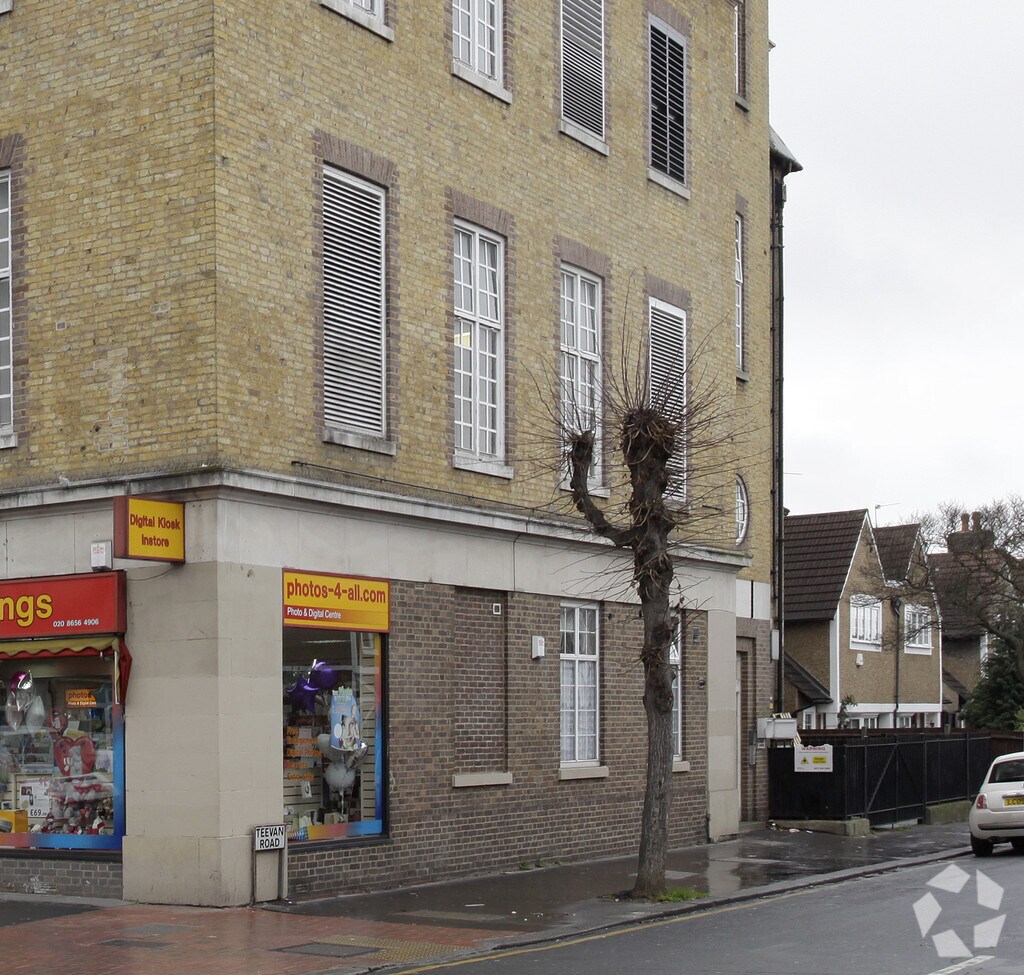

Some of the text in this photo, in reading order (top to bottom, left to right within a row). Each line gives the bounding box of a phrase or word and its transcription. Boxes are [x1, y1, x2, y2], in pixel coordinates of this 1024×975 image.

[130, 514, 181, 530] Digital Kiosk
[141, 534, 170, 547] Instore
[287, 578, 386, 603] photos-4-all.com
[287, 607, 342, 619] Photo & Digital Centre
[66, 619, 82, 627] 8656
[83, 618, 100, 626] 4906
[256, 825, 284, 837] TEEVAN
[259, 838, 280, 849] ROAD
